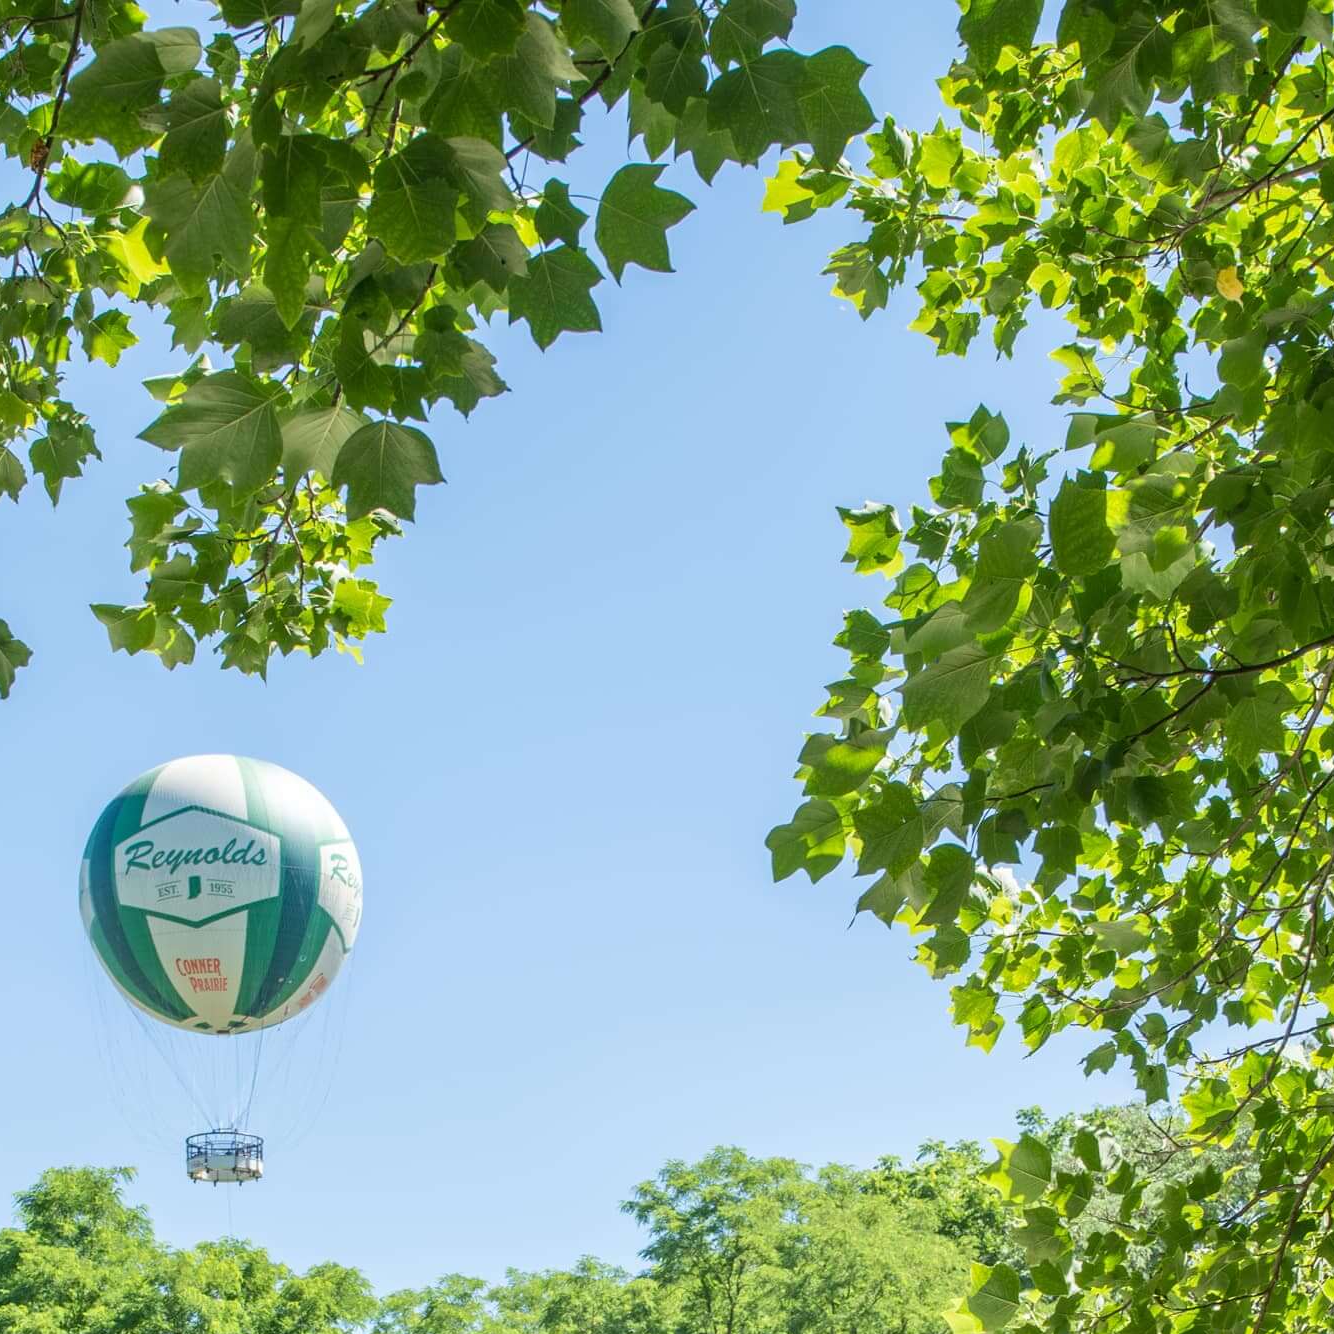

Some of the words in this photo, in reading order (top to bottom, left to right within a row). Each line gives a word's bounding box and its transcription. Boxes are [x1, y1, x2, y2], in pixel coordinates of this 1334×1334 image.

[124, 838, 267, 875] Reynolds
[157, 884, 180, 898] EST.
[209, 882, 233, 895] 1955
